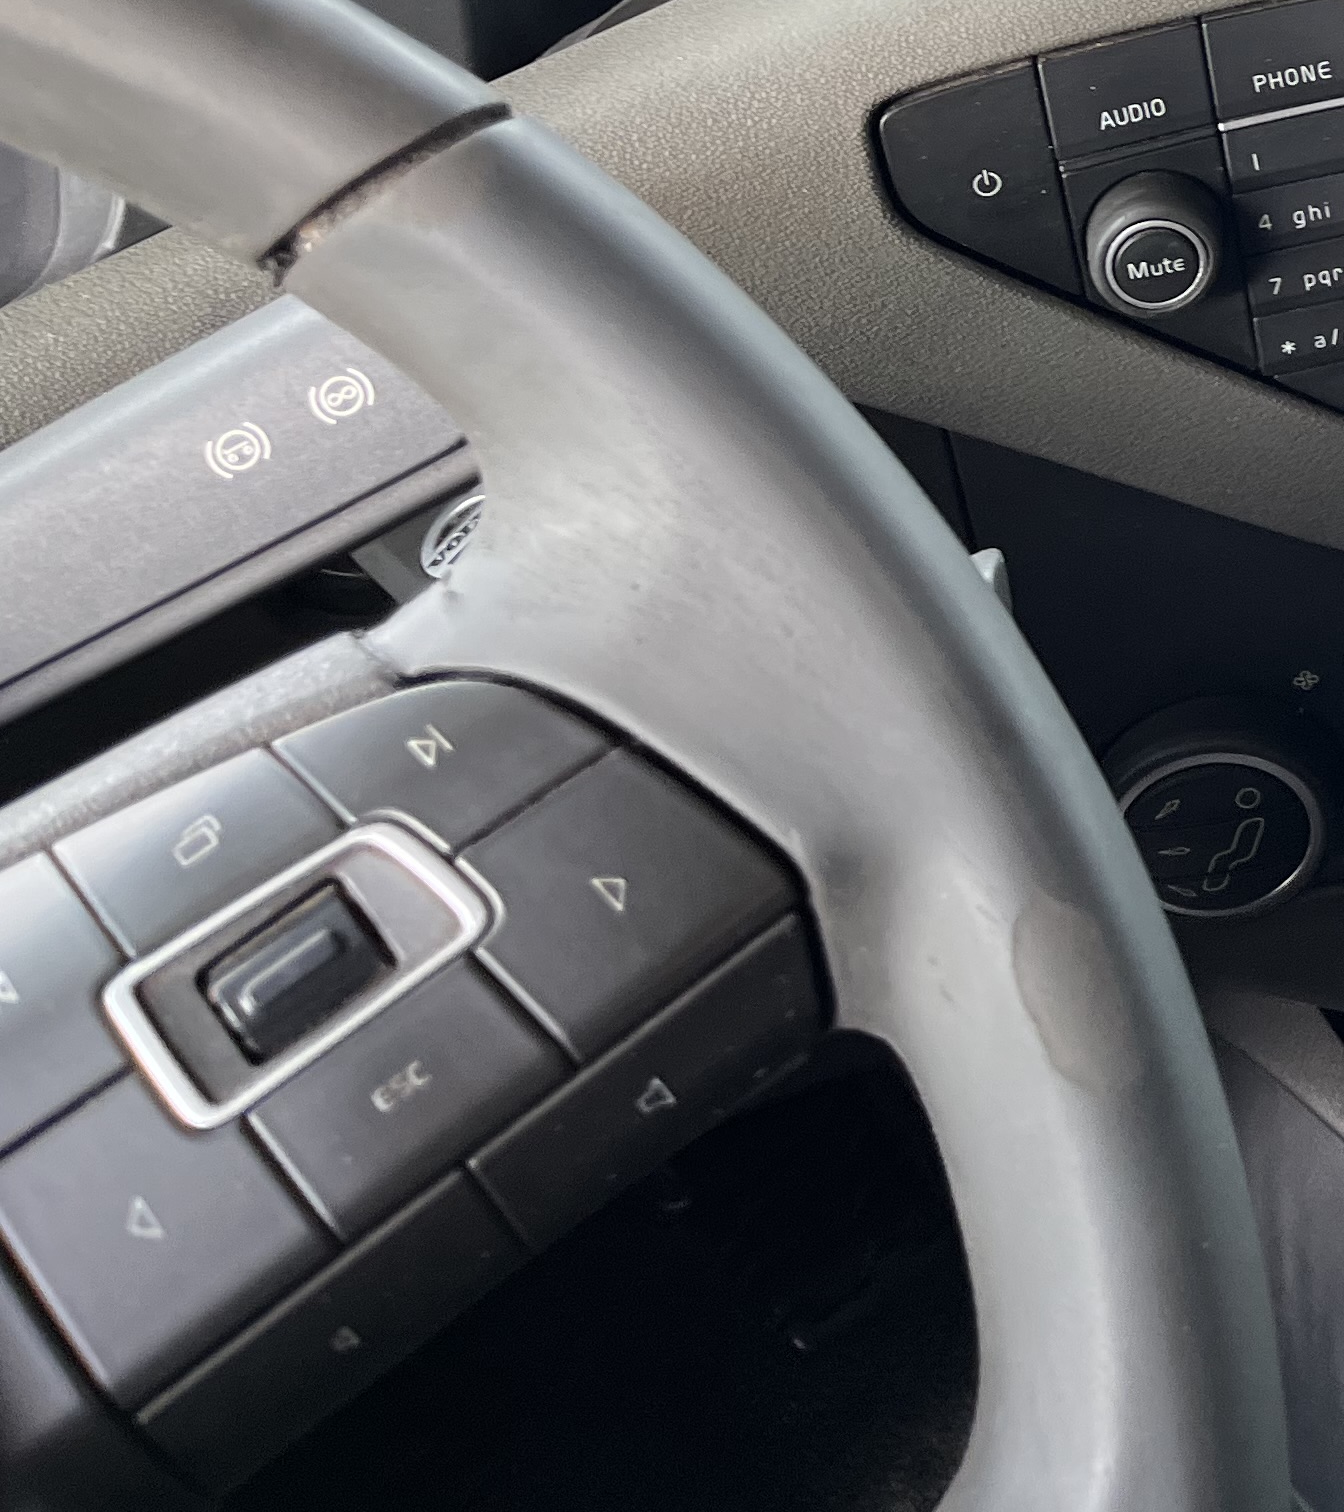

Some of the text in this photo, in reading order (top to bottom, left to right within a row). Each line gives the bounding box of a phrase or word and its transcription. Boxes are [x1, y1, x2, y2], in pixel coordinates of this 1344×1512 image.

[1252, 60, 1333, 93] PHONE
[1100, 98, 1166, 131] AUDIO
[1258, 204, 1331, 230] 4 ghi
[1127, 257, 1186, 280] Mute
[1268, 277, 1282, 295] 7
